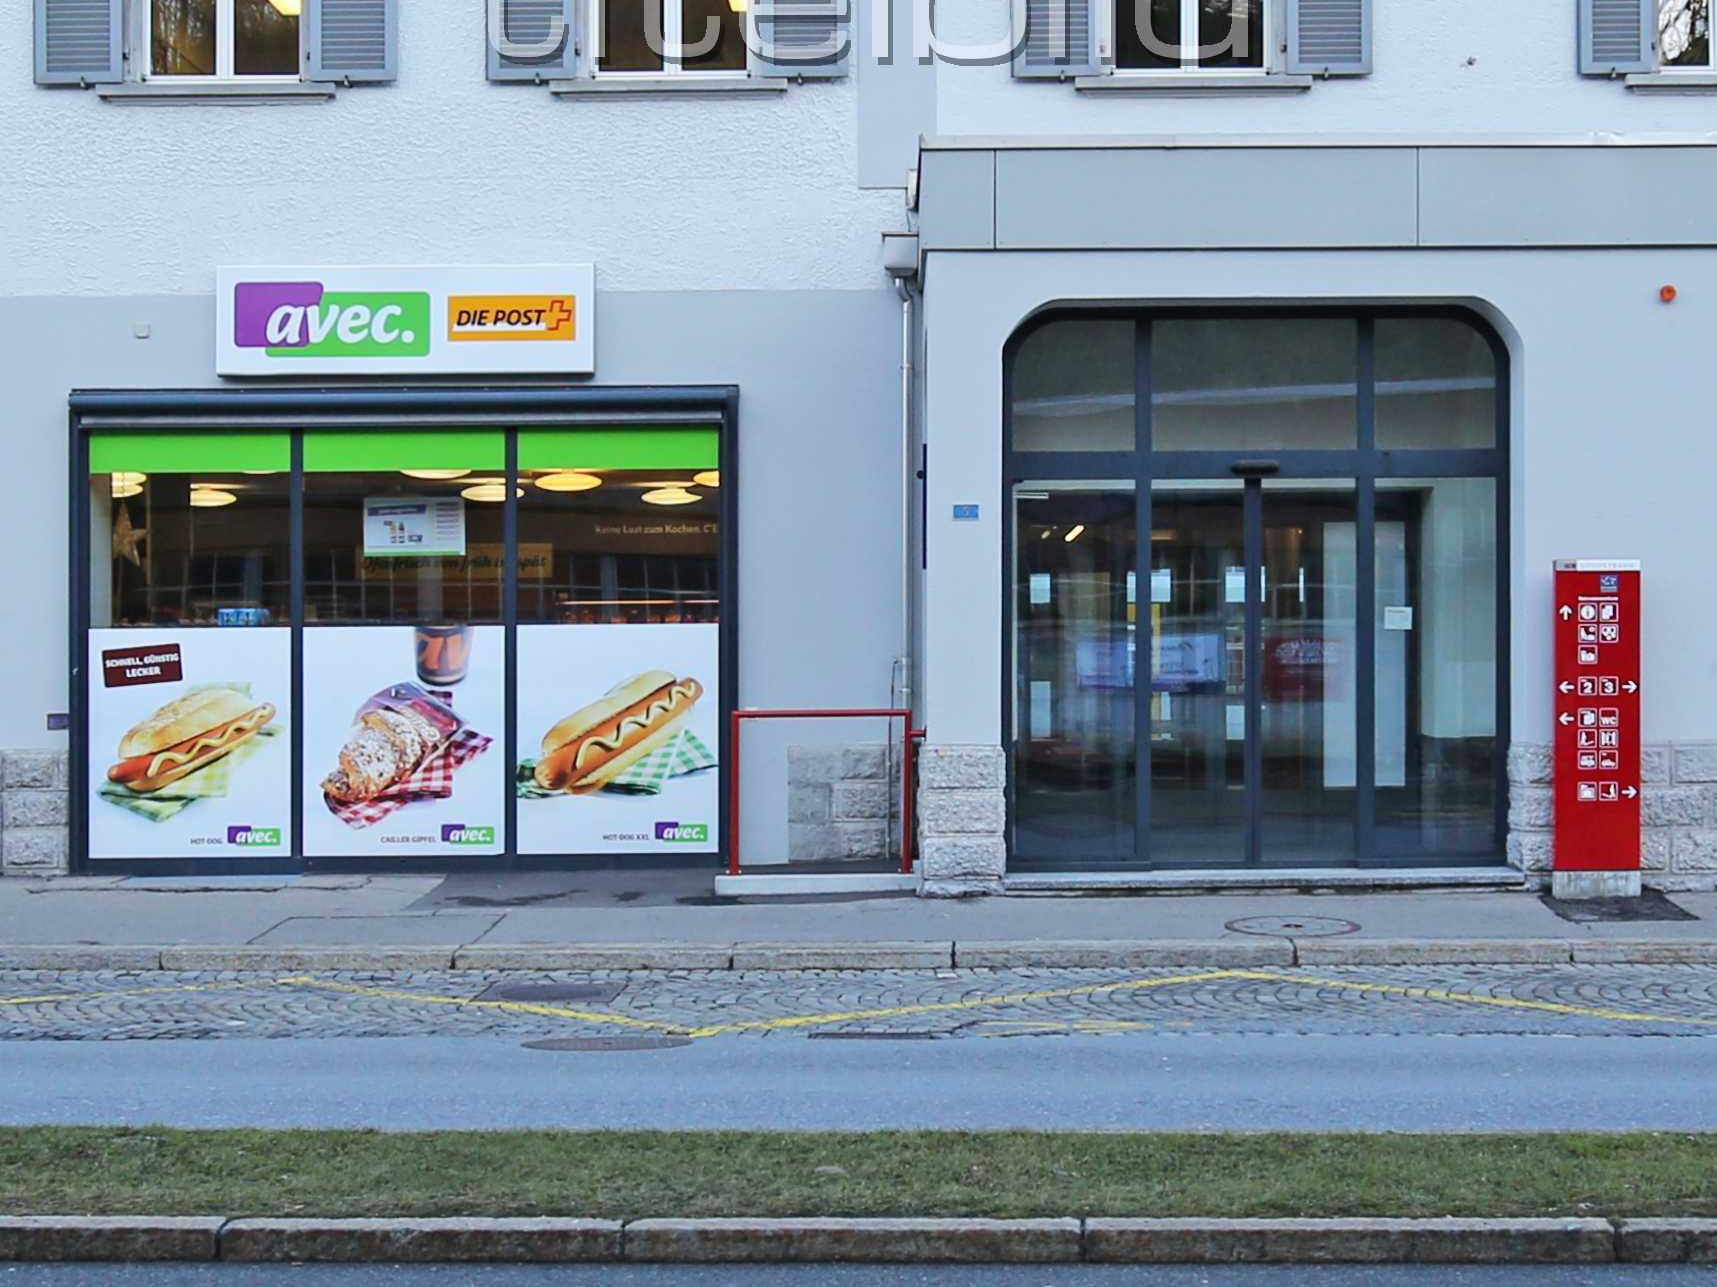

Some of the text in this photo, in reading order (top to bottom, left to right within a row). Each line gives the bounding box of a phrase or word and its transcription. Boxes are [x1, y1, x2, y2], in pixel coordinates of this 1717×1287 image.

[456, 309, 546, 326] DIE POST
[266, 304, 416, 344] avec.
[126, 667, 161, 677] LECKER
[1583, 682, 1613, 693] 2 3
[236, 831, 277, 843] avec.
[449, 829, 491, 841] avec.
[663, 826, 705, 839] avec.
